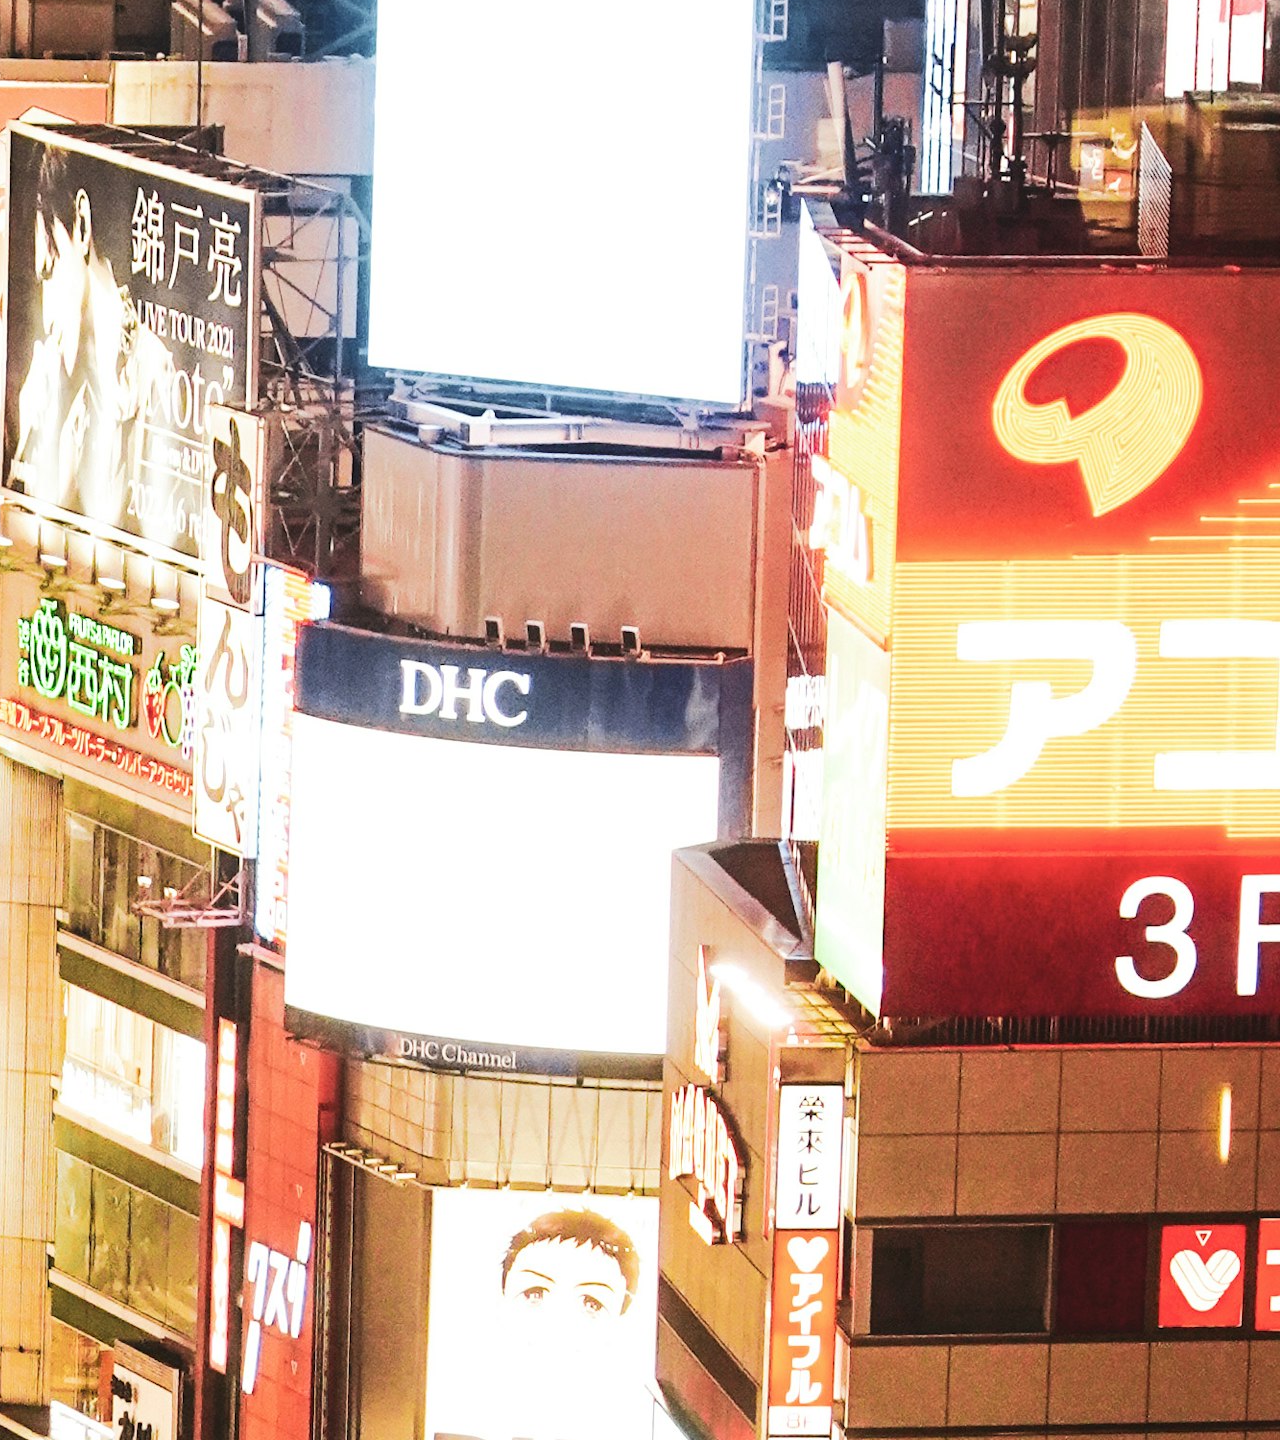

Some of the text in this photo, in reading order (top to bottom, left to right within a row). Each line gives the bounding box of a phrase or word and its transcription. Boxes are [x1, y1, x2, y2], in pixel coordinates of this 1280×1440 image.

[130, 186, 243, 308] 錦戸亮
[169, 310, 207, 352] TOUR
[207, 323, 234, 359] 2021
[68, 640, 133, 731] 西村
[398, 658, 531, 728] DHC
[399, 1036, 518, 1072] DHC Channel
[786, 1272, 825, 1405] アイフル
